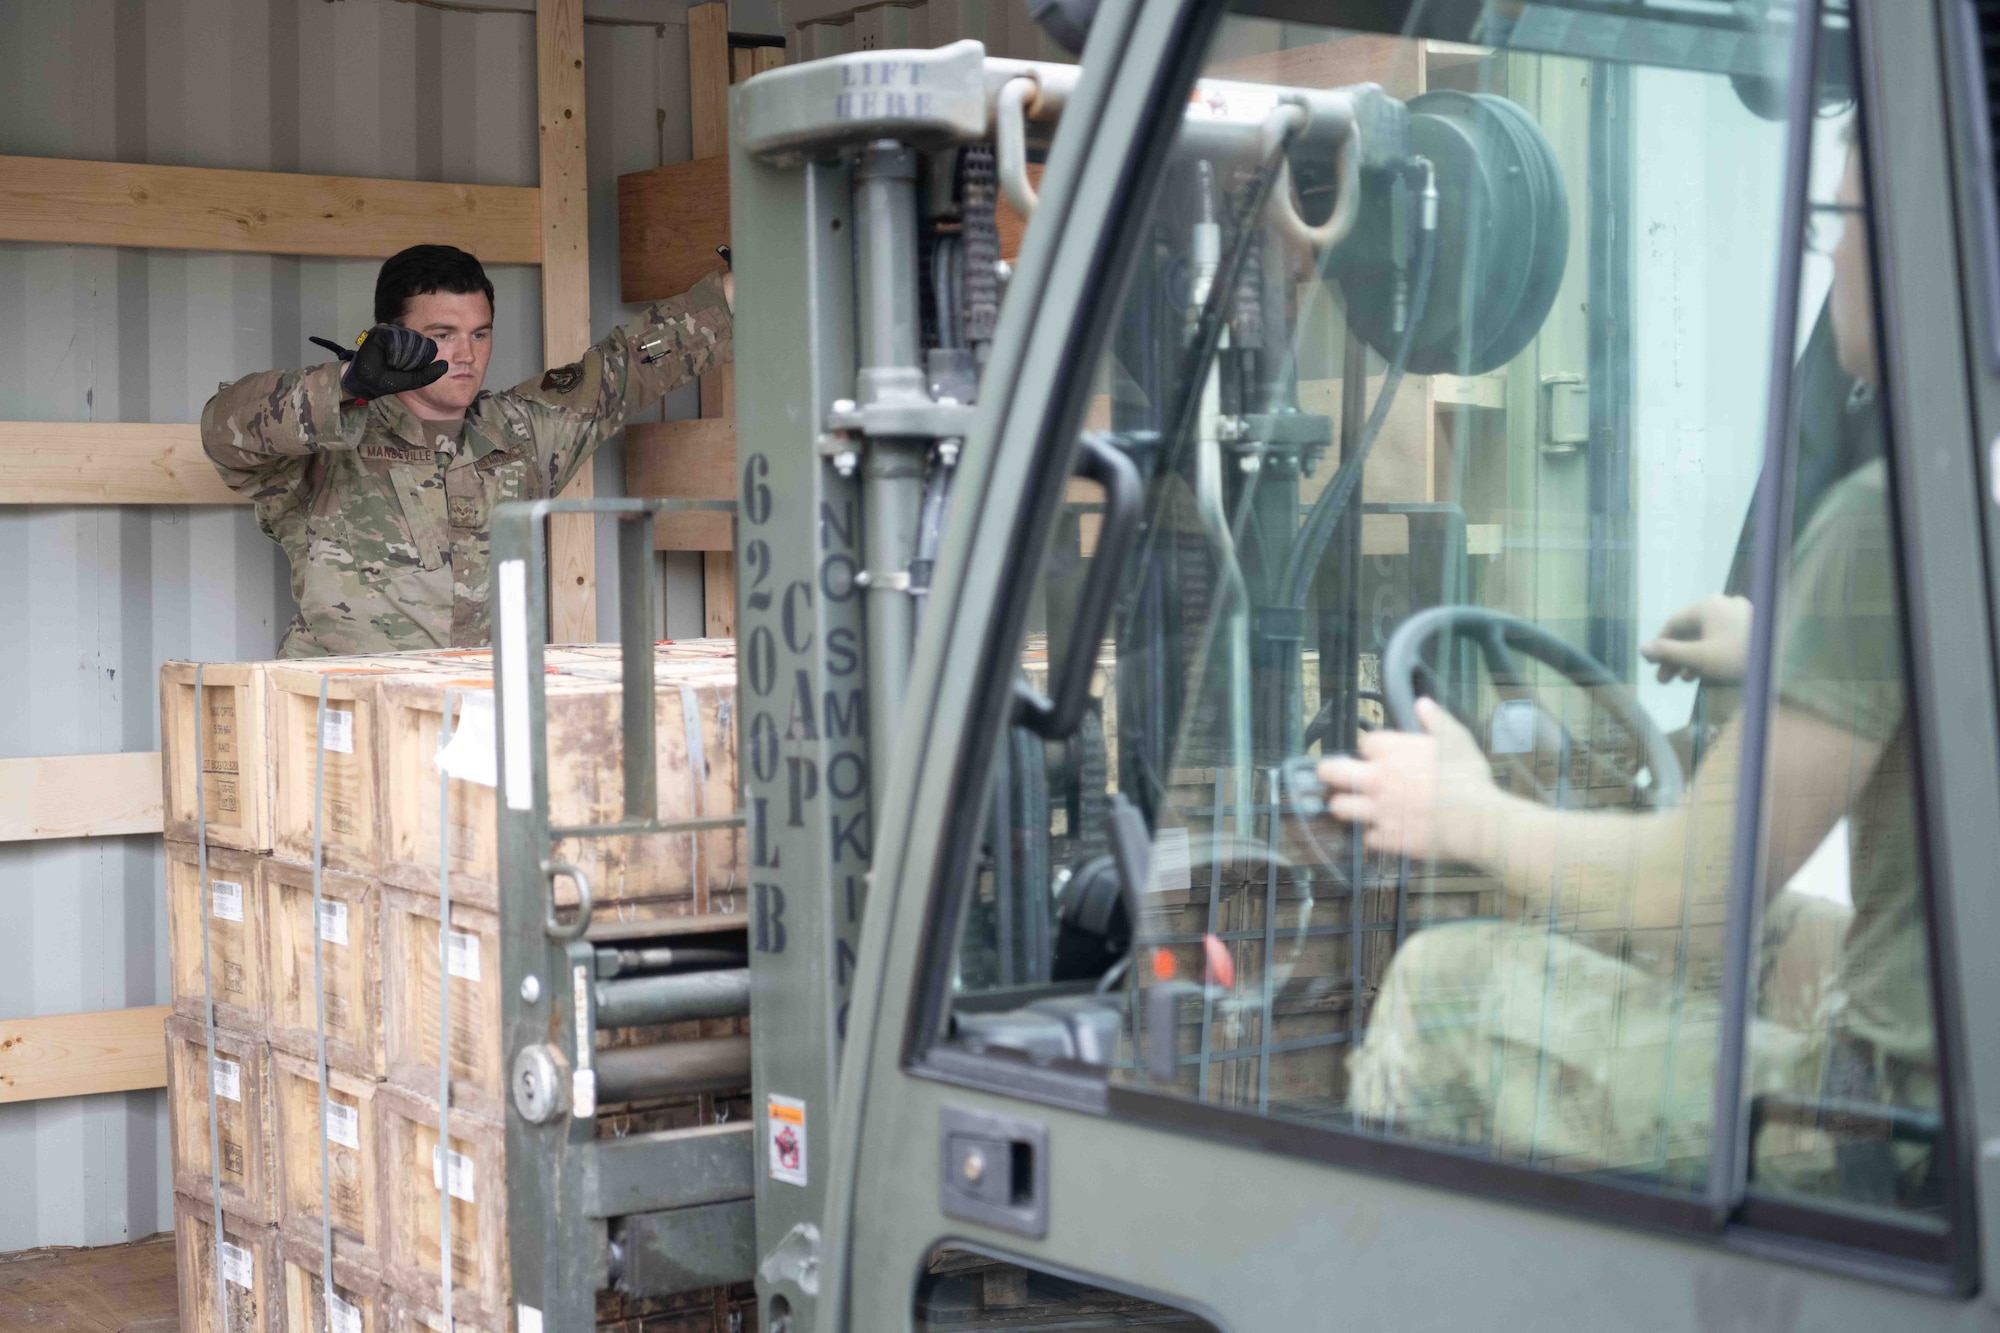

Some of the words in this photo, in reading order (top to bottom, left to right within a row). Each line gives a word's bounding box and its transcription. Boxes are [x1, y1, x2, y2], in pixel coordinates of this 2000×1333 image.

[841, 61, 927, 87] LIFT
[835, 91, 933, 119] HERE
[366, 445, 432, 461] MANDEVILLE
[819, 501, 858, 603] NO
[782, 580, 820, 828] CAP
